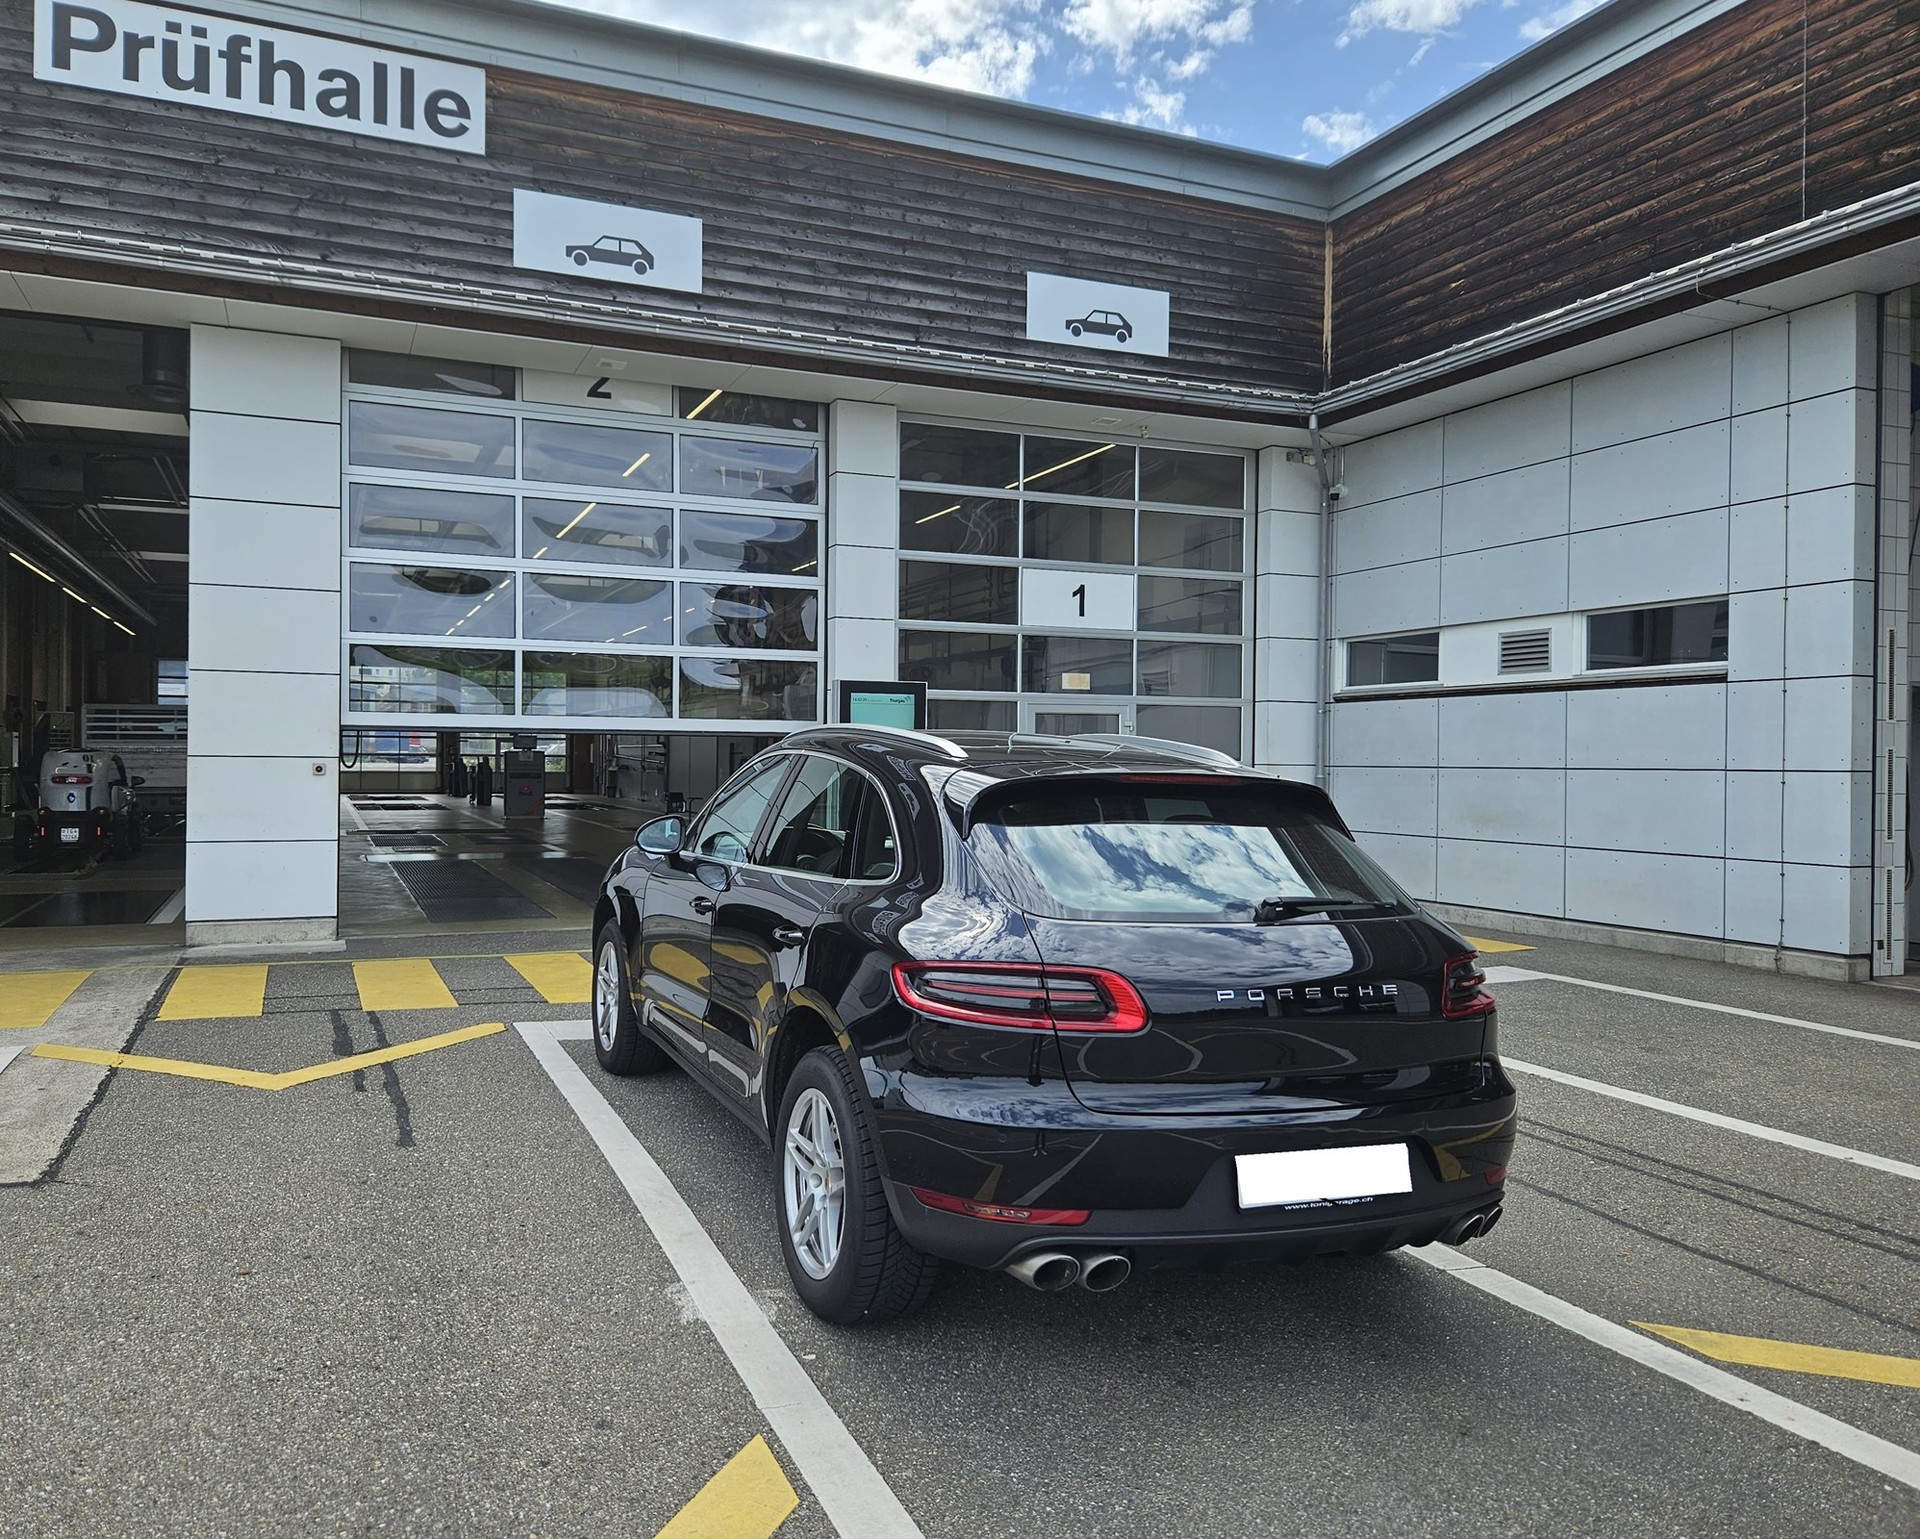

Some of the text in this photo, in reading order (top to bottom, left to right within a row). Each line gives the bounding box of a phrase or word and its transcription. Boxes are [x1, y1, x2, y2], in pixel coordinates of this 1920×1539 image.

[51, 1, 471, 138] Prüfhalle
[1072, 584, 1086, 617] 1
[1217, 984, 1398, 1002] PORSCHE
